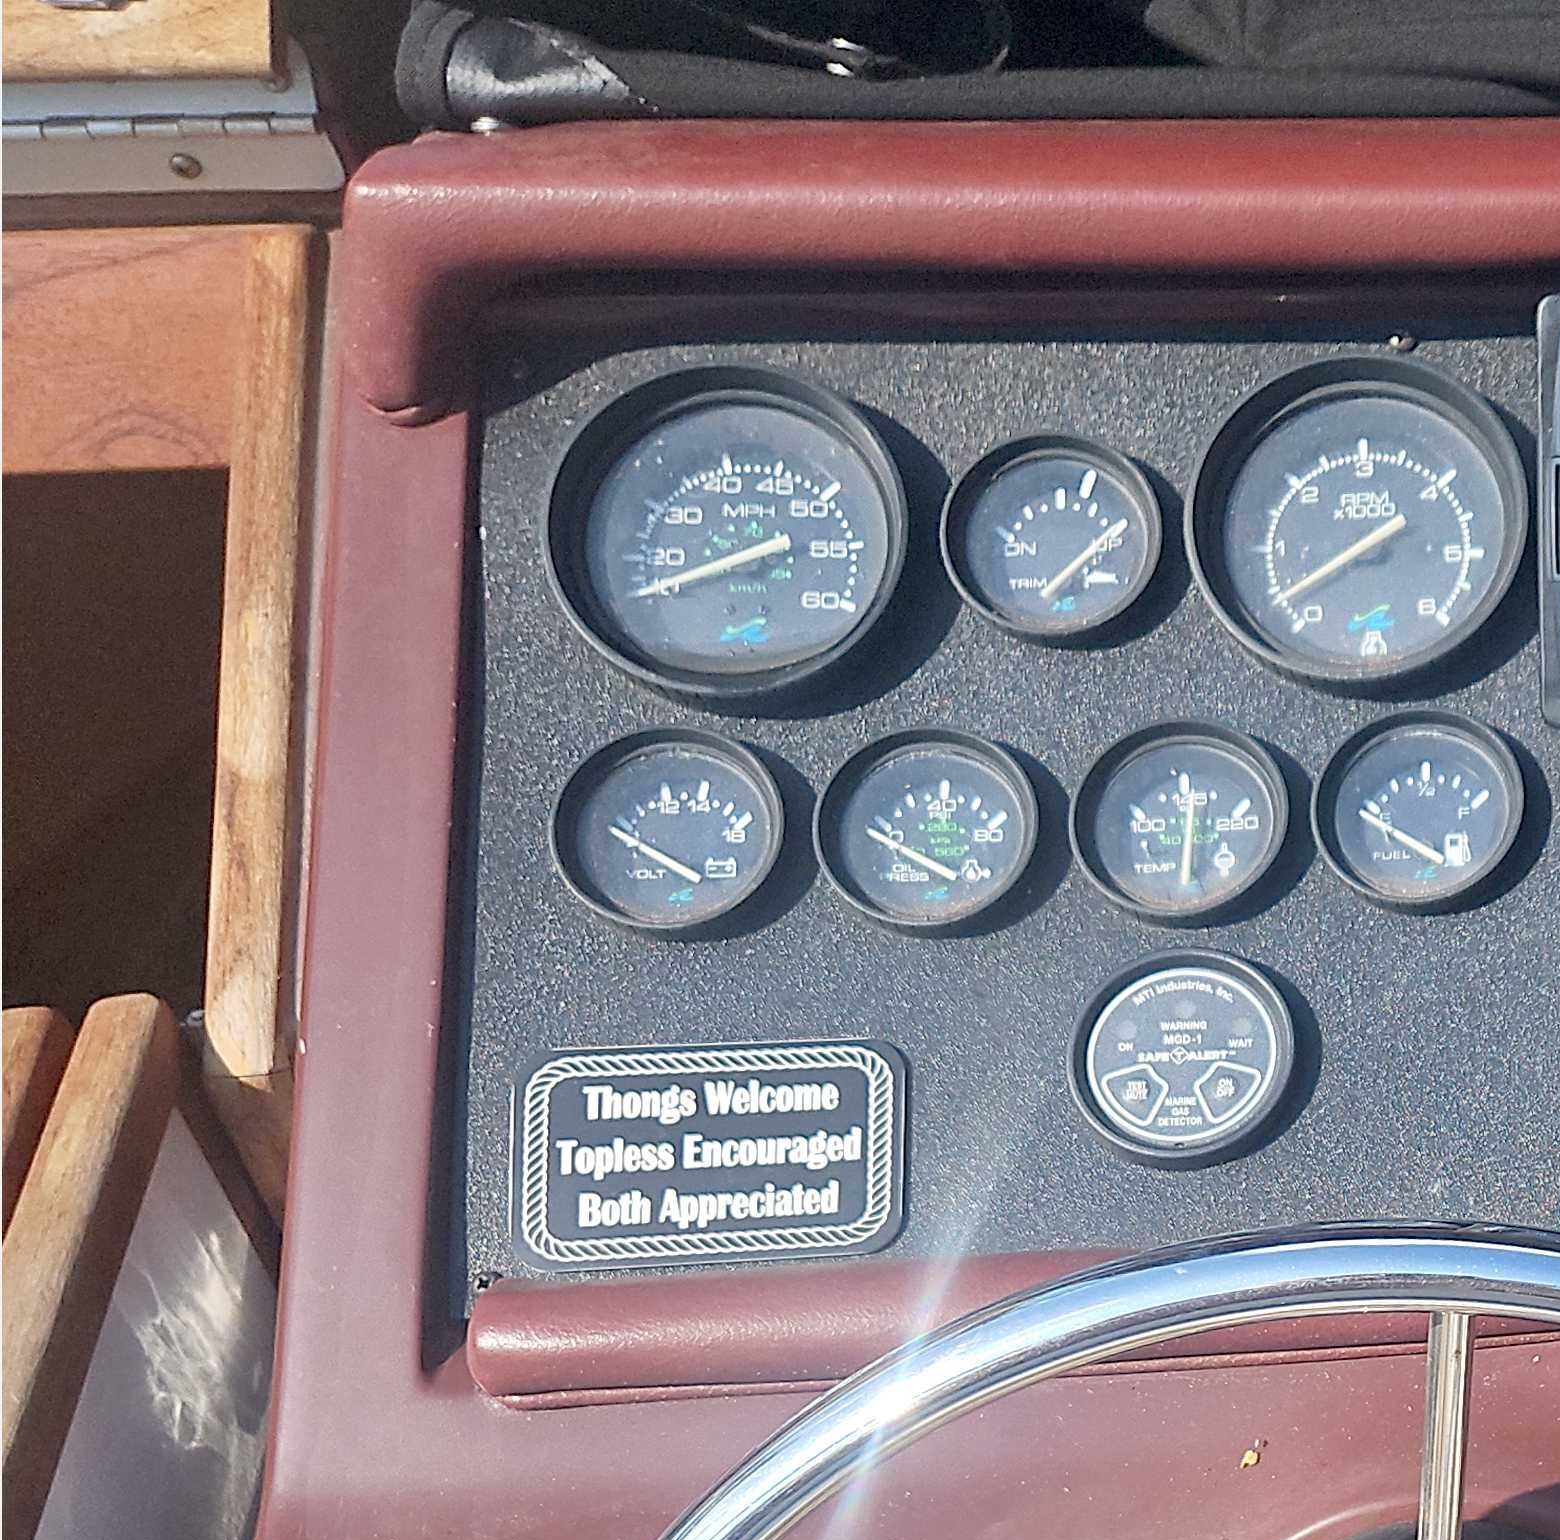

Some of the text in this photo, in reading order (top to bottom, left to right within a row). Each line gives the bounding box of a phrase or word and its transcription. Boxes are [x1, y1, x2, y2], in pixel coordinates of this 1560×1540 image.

[1356, 461, 1374, 477] 3
[703, 476, 742, 494] 40
[756, 476, 794, 495] 45
[1301, 486, 1319, 503] 2
[1341, 491, 1390, 506] RPM
[1420, 485, 1440, 501] 4
[664, 506, 703, 525] 30
[722, 503, 776, 519] MPH
[789, 500, 829, 518] 50
[808, 540, 848, 558] 55
[1275, 540, 1287, 557] 1
[650, 548, 685, 566] 20
[1008, 577, 1048, 590] TRIM
[801, 592, 840, 610] 60
[1304, 605, 1323, 622] 0
[658, 800, 681, 814] 12
[687, 799, 711, 813] 14
[926, 800, 957, 812] 40
[1458, 807, 1470, 820] F
[1130, 819, 1166, 833] 100
[1216, 817, 1260, 831] 220
[974, 829, 1005, 843] 80
[1373, 850, 1411, 861] FUEL
[625, 868, 667, 880] VOLT
[1134, 863, 1177, 873] TEMP
[1160, 1021, 1208, 1032] WARNING
[1163, 1033, 1202, 1045] MGD-1
[1229, 1038, 1253, 1048] WAIT
[1118, 1042, 1134, 1052] ON
[1218, 1078, 1233, 1088] ON
[1216, 1087, 1235, 1098] OFF
[583, 1079, 840, 1126] Thongs Welcome
[1171, 1106, 1190, 1116] GAS
[1158, 1116, 1202, 1127] DETECTOR
[555, 1126, 864, 1182] Topless Encouraged
[578, 1179, 840, 1231] Both Appreciated
